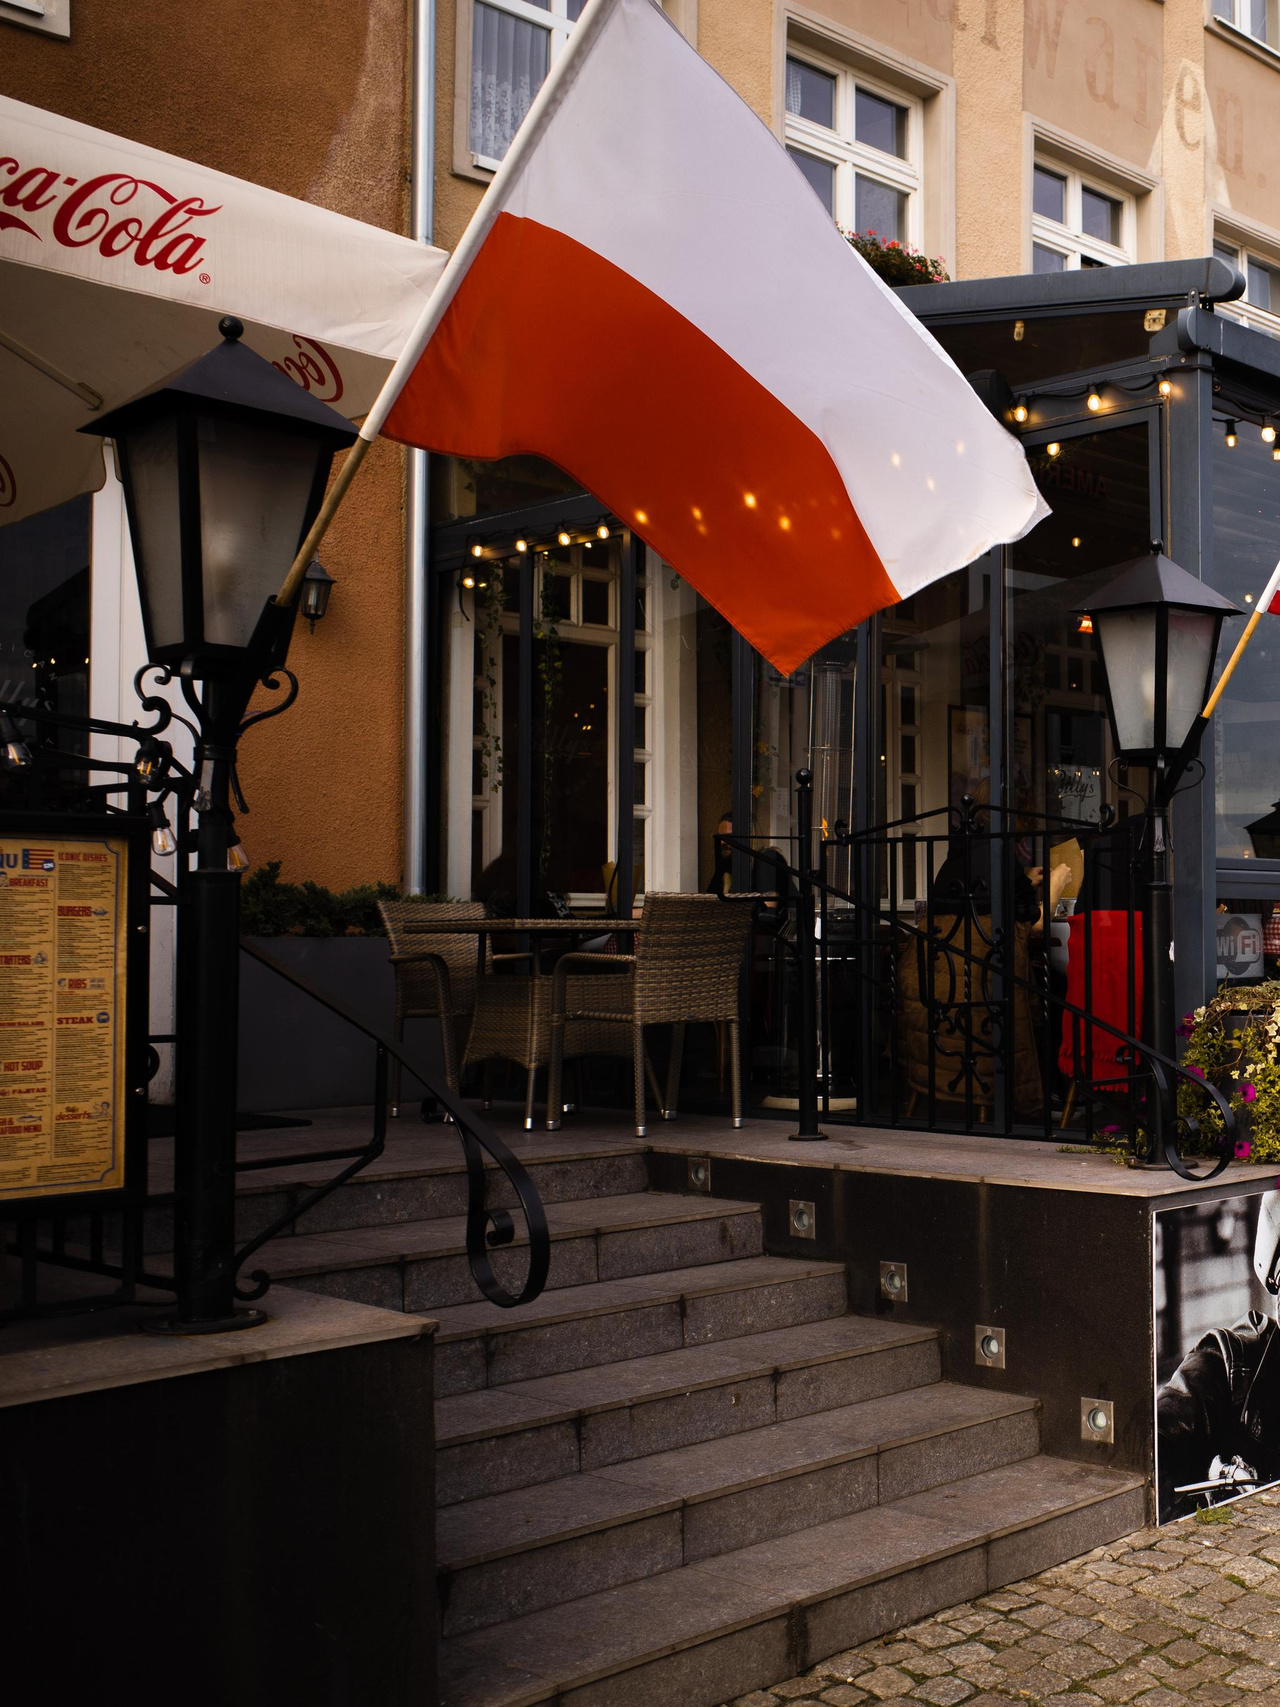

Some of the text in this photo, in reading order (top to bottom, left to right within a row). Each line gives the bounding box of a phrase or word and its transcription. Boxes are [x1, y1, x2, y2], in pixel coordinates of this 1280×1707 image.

[9, 878, 48, 887] BREAKFAST
[57, 906, 92, 916] BURGERS
[68, 979, 87, 989] RIBS
[56, 1016, 94, 1025] STEAK
[3, 1060, 43, 1071] HOT SOUP
[55, 1111, 91, 1121] desserts
